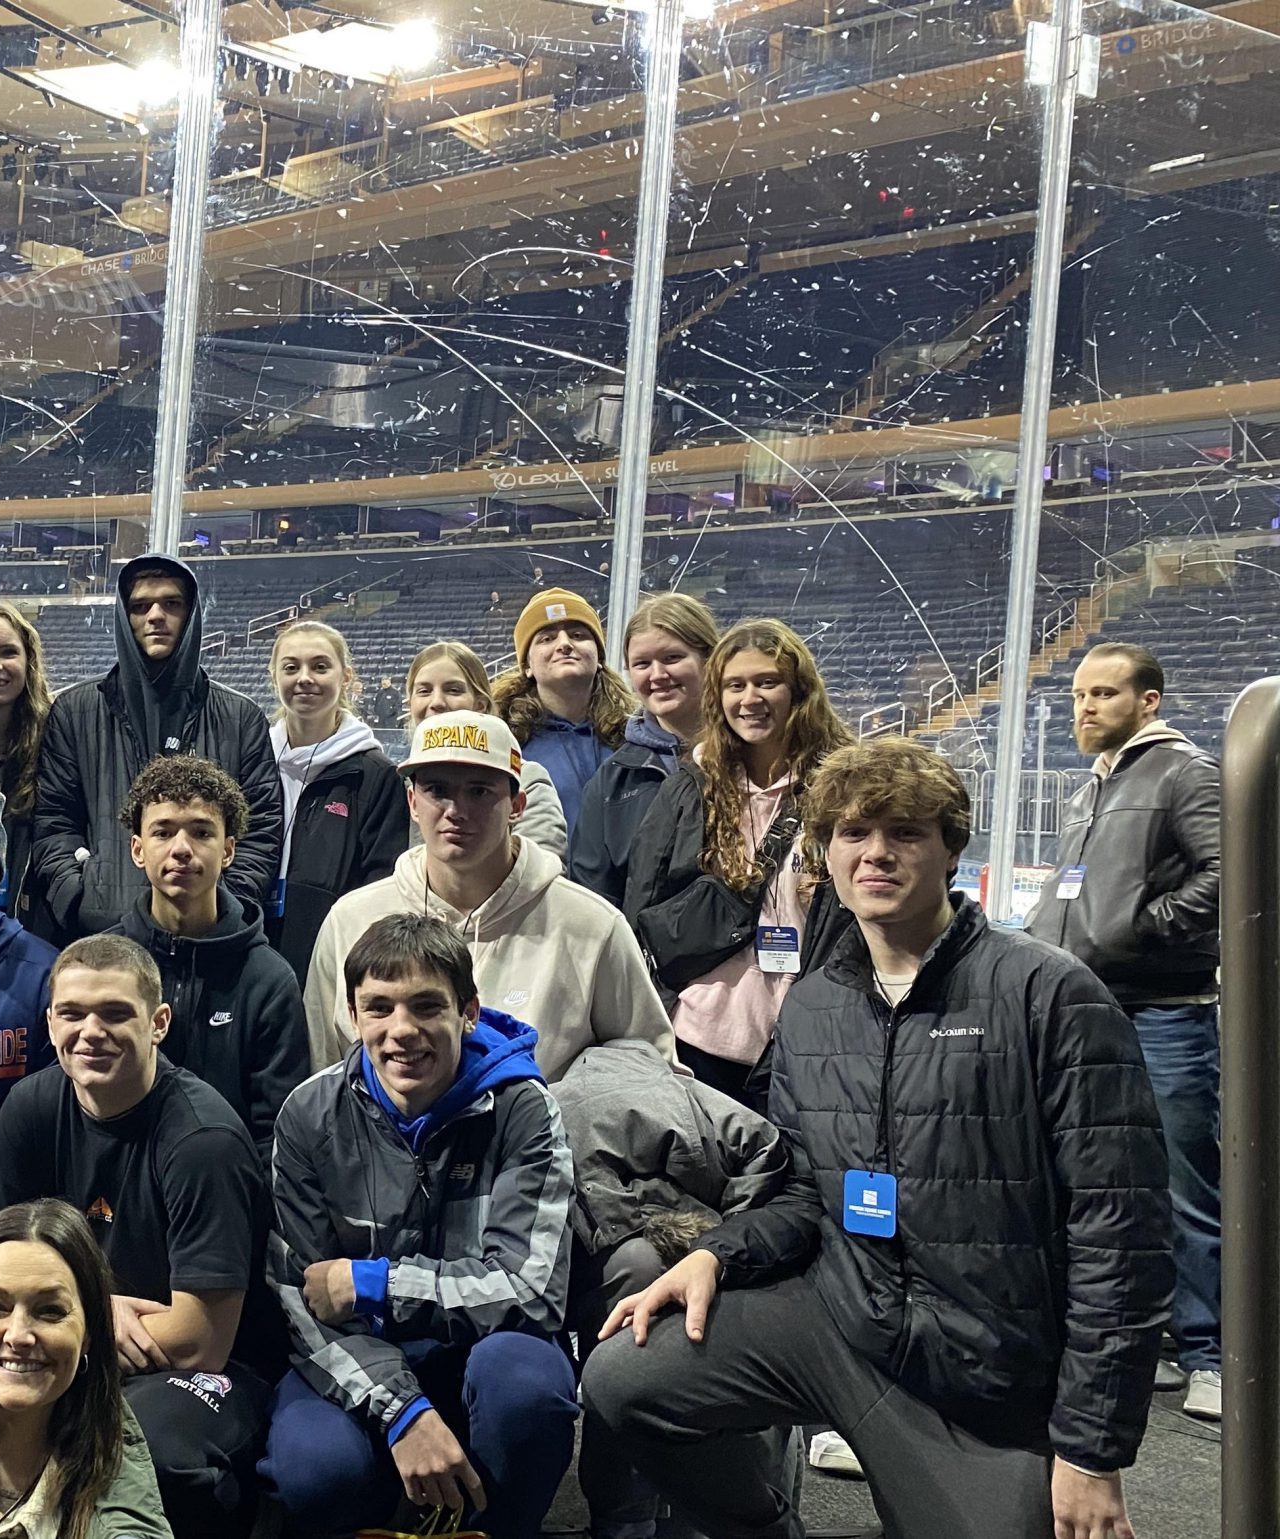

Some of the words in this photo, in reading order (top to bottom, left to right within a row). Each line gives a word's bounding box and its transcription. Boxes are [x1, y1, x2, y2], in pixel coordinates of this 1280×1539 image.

[80, 257, 120, 276] CHASE
[518, 471, 585, 486] LEXUS
[421, 724, 489, 754] ESPAÑA
[213, 1011, 231, 1021] NIKE
[166, 1376, 220, 1414] FOOTBALL
